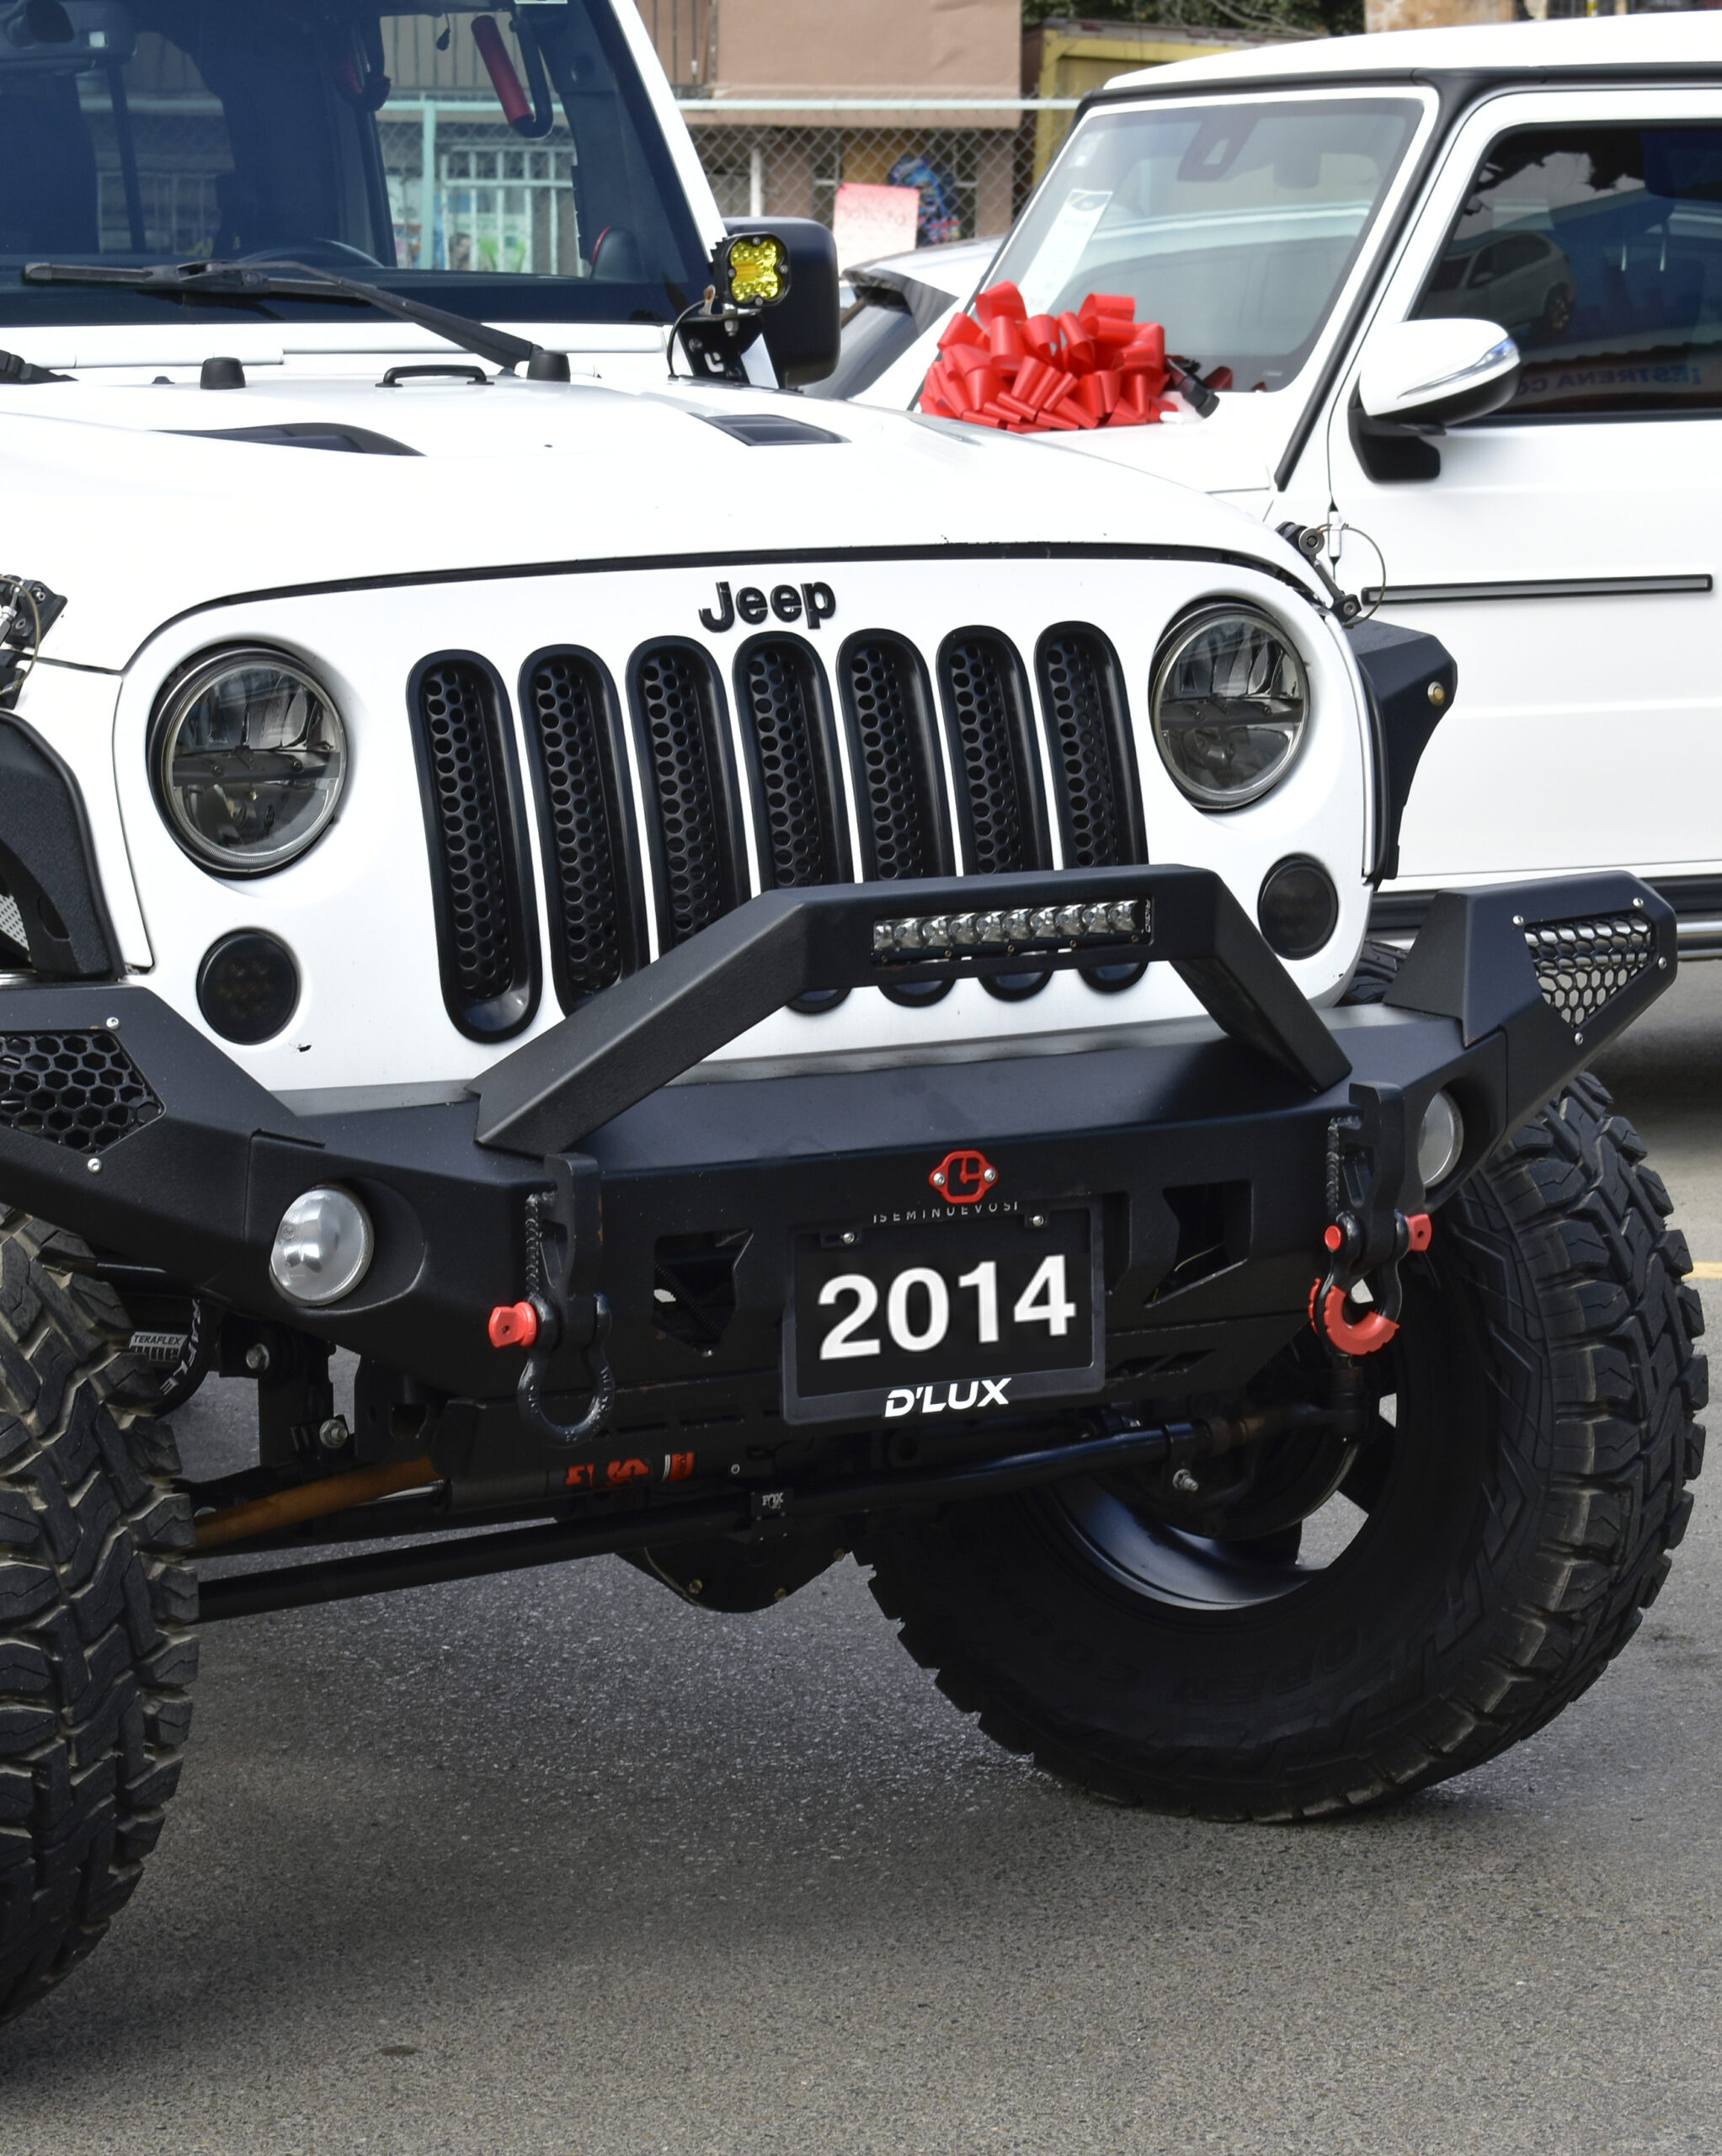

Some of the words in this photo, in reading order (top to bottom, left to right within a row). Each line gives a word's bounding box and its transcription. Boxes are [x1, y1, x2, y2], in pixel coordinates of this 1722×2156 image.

[698, 581, 836, 633] Jeep
[818, 1255, 1076, 1360] 2014
[134, 1335, 182, 1346] TERAFLEX
[884, 1377, 1012, 1417] D'LUX
